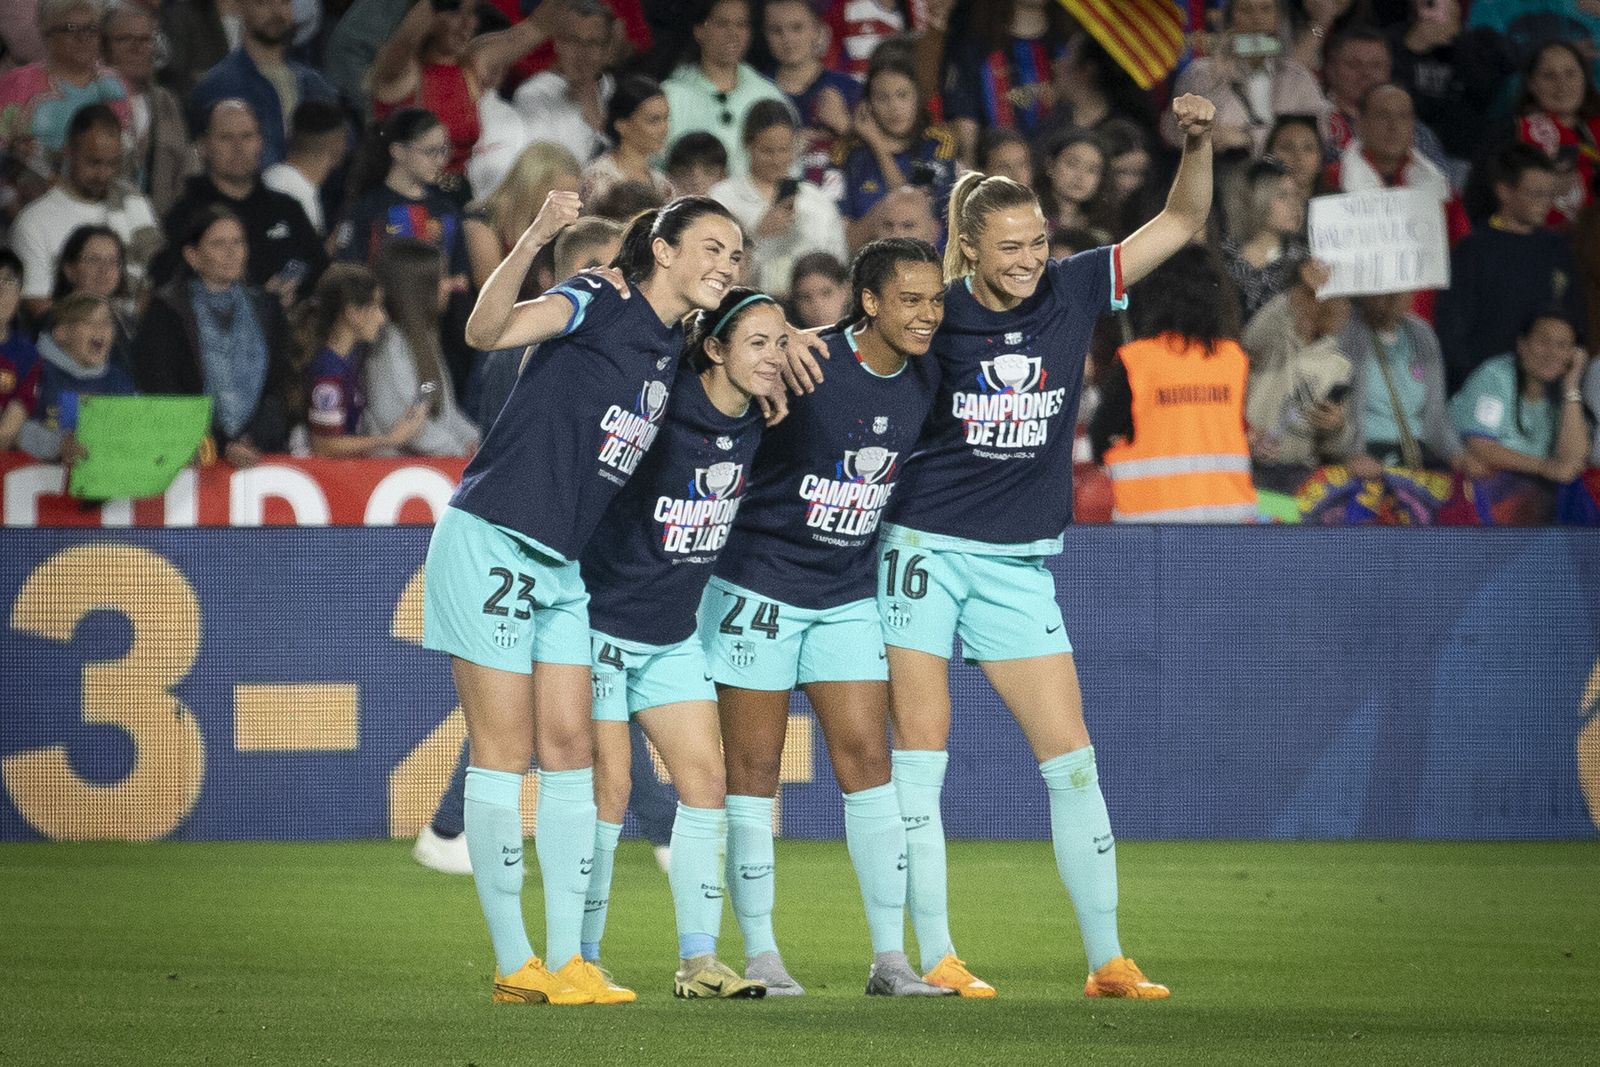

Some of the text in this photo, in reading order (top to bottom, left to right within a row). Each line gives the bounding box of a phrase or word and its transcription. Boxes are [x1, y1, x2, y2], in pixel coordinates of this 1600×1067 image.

[952, 387, 1066, 421] CAMPIONES
[966, 419, 1048, 449] DE LLIGA
[598, 436, 627, 468] DE
[799, 474, 896, 510] CAMPIONE
[654, 496, 743, 526] CAMPION
[806, 503, 840, 532] DE
[664, 523, 732, 553] DE LLIG
[883, 548, 928, 600] 16
[482, 566, 537, 620] 23
[719, 591, 779, 640] 24
[901, 815, 930, 824] arça
